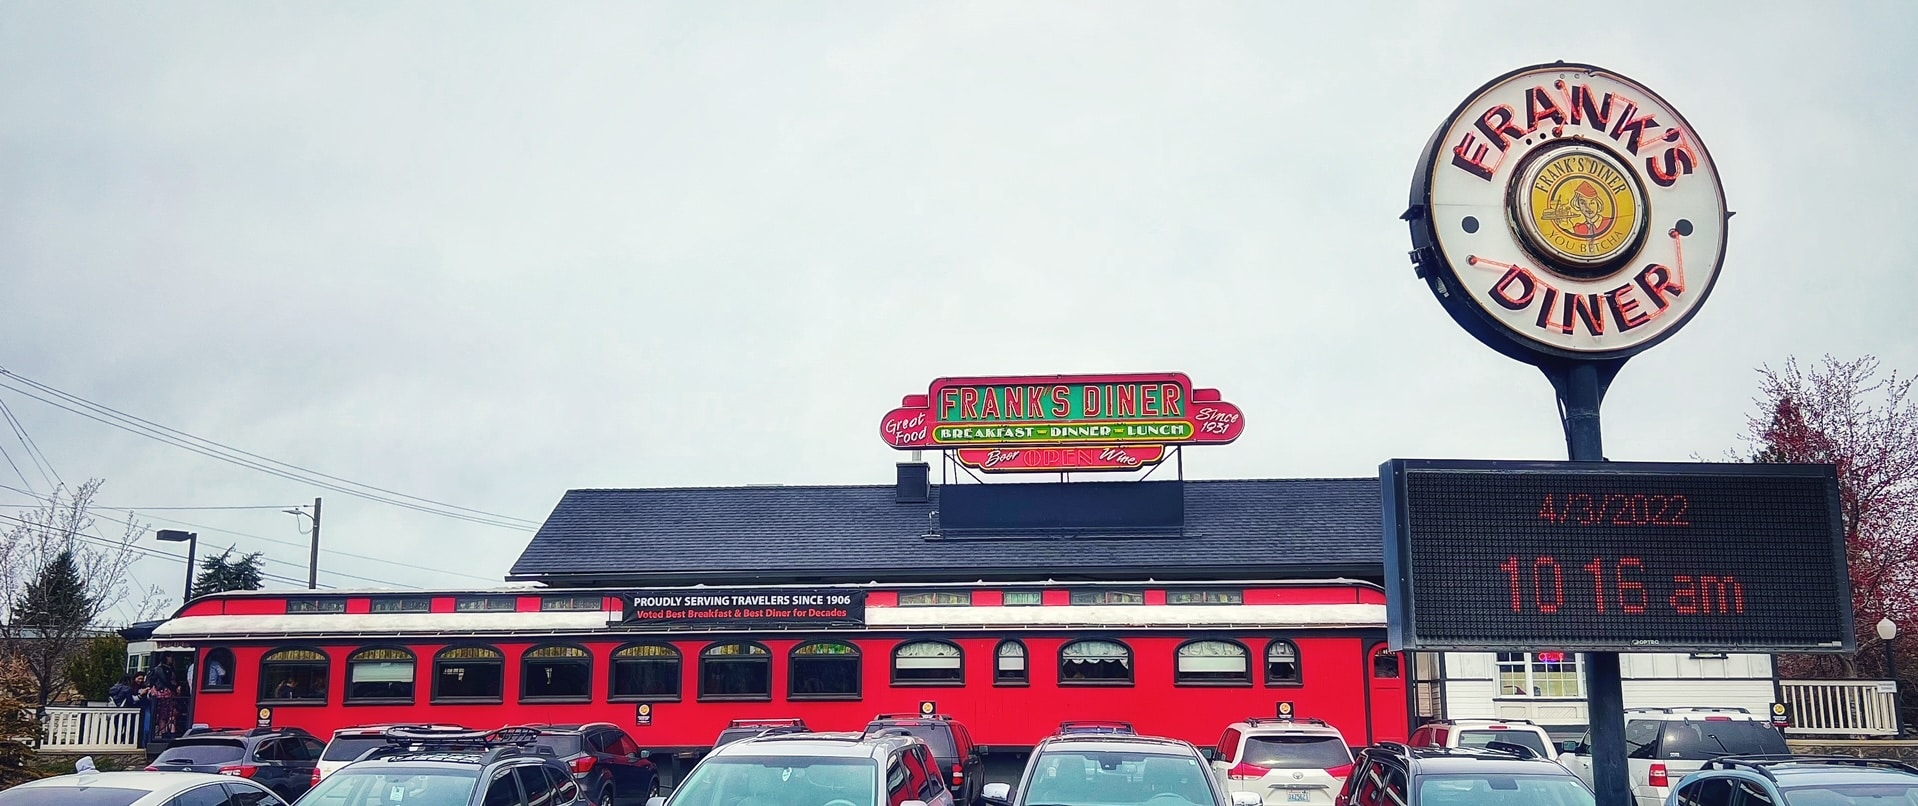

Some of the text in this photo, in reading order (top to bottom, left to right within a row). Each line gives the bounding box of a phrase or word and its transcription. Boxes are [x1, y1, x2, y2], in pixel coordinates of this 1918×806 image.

[1451, 82, 1697, 188] FRANK'S
[1534, 157, 1627, 195] FRANK'S DINER
[1548, 230, 1623, 253] YOU BETCHA
[1488, 262, 1684, 337] DINER
[940, 383, 1181, 420] FRANK'S DINER
[885, 412, 926, 434] Great
[1195, 407, 1239, 424] Since
[895, 425, 927, 446] Food
[940, 425, 1184, 439] BREAKFAST DINNER LUNCH
[1200, 421, 1230, 434] 1931
[985, 449, 1020, 467] Beer
[1023, 449, 1093, 466] OPEN
[1099, 447, 1138, 465] Wine
[1538, 493, 1690, 526] 4/3/2022
[1499, 555, 1744, 614] 10 16 am
[634, 595, 851, 607] PROUDLY SERVING TRAVELERS SINCE 1906
[637, 607, 847, 619] Voted Best Breakfast & Best Diner for Decades
